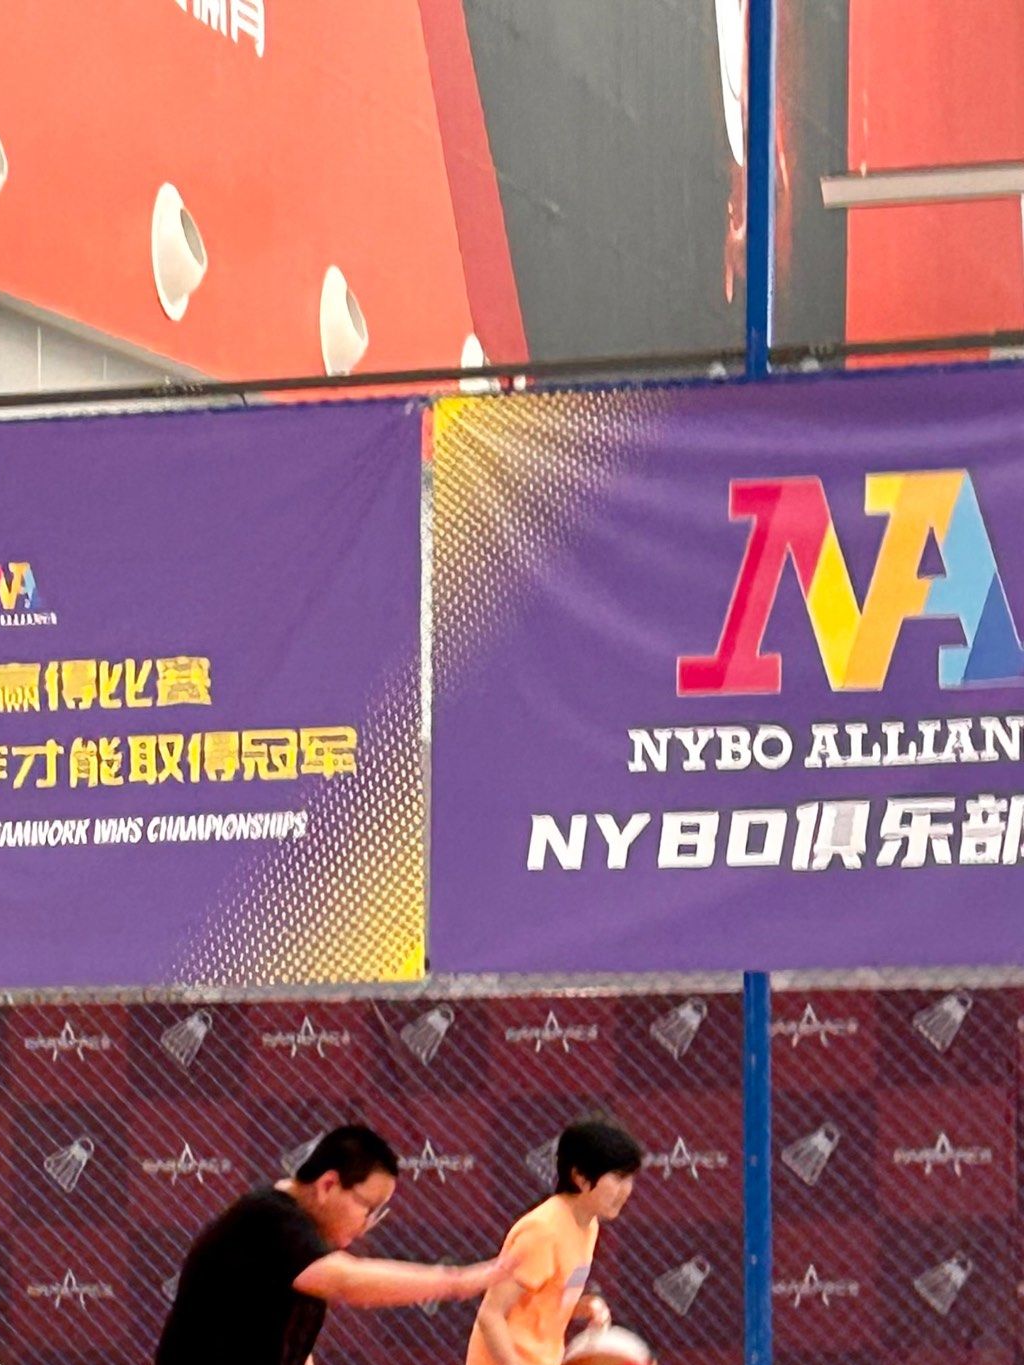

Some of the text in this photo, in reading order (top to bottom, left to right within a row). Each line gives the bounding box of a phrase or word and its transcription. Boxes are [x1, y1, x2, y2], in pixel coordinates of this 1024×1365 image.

[627, 724, 793, 773] NYBO
[93, 816, 143, 845] WINS
[147, 809, 308, 843] CHAMPIONSHIPS
